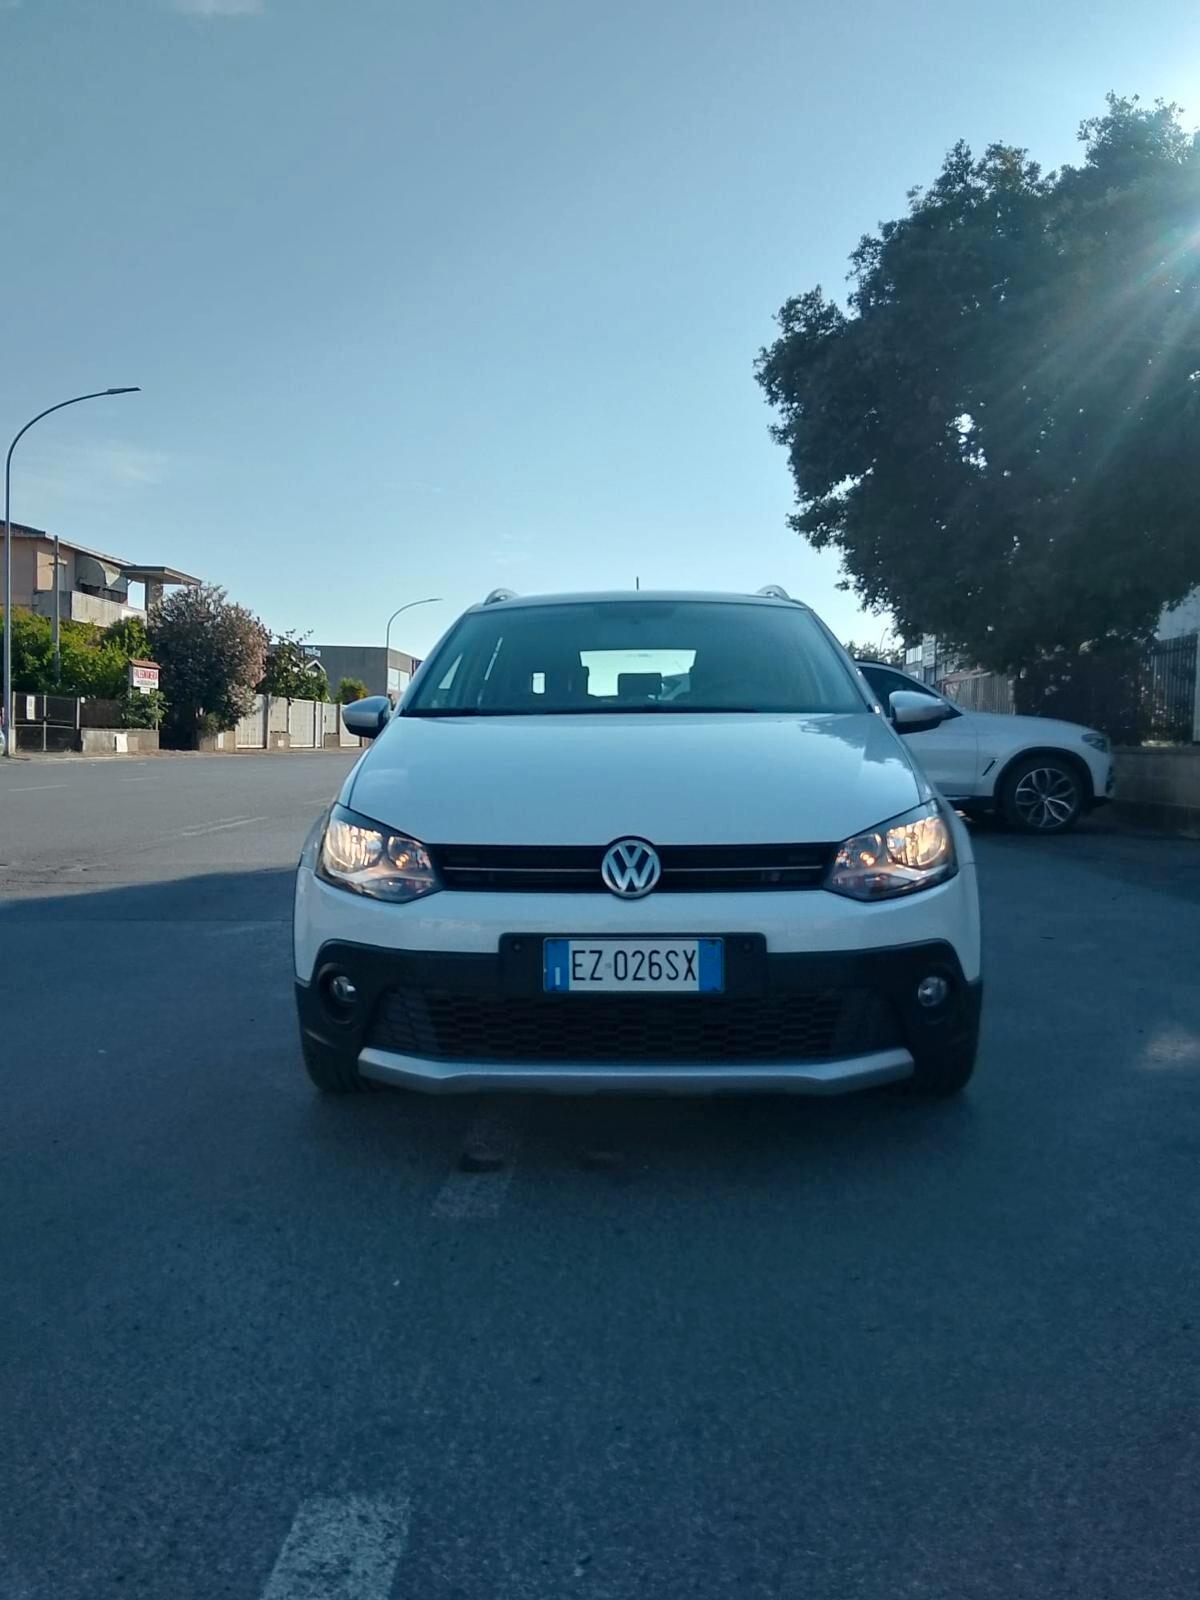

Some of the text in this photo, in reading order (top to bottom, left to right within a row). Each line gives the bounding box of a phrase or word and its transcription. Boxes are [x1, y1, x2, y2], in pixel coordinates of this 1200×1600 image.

[603, 840, 659, 896] VW
[572, 949, 697, 981] EZ 026SX
